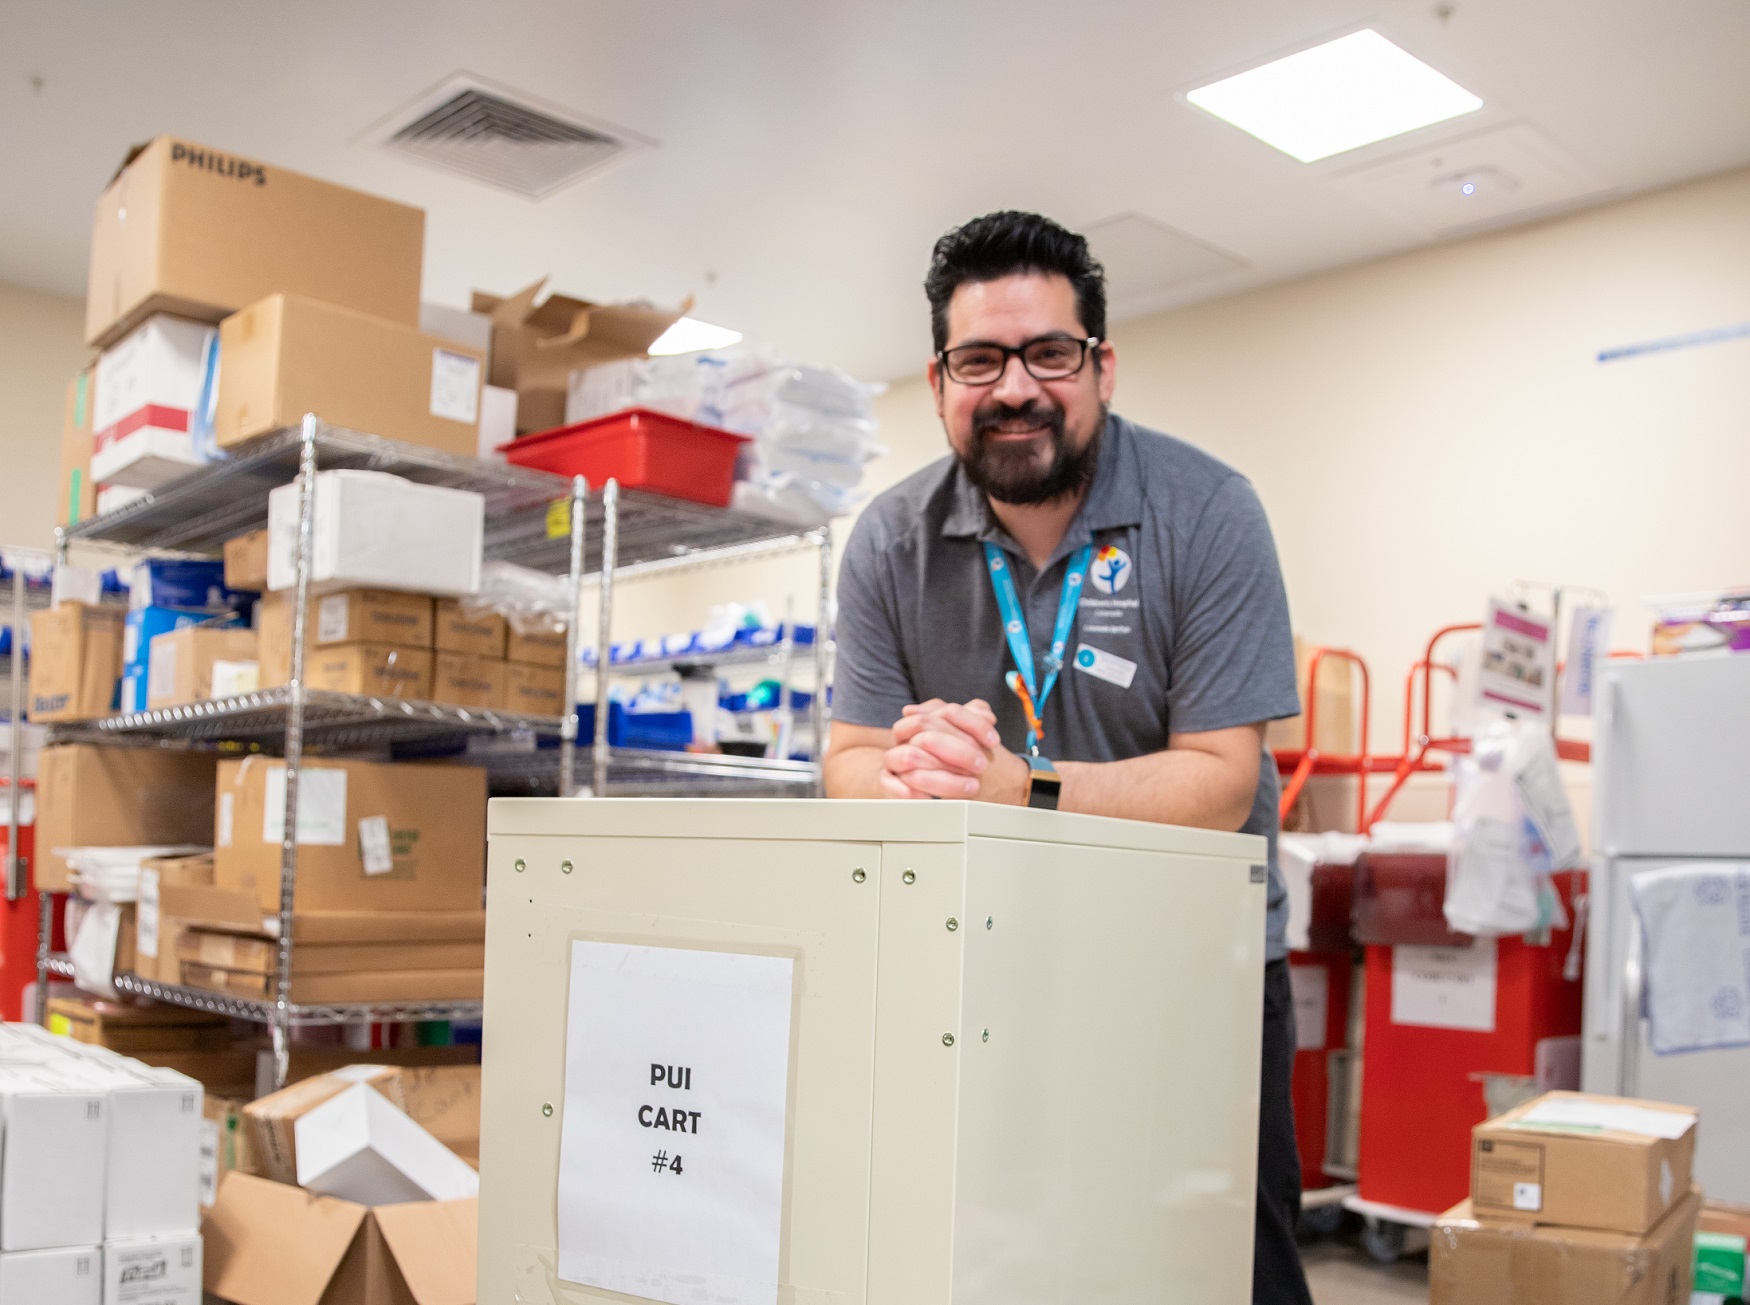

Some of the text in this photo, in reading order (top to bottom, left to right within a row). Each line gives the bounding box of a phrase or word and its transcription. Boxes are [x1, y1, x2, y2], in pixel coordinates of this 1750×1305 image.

[171, 143, 266, 186] PHILIPS
[650, 1063, 691, 1090] PUI
[638, 1104, 702, 1134] CART
[651, 1149, 684, 1175] #4
